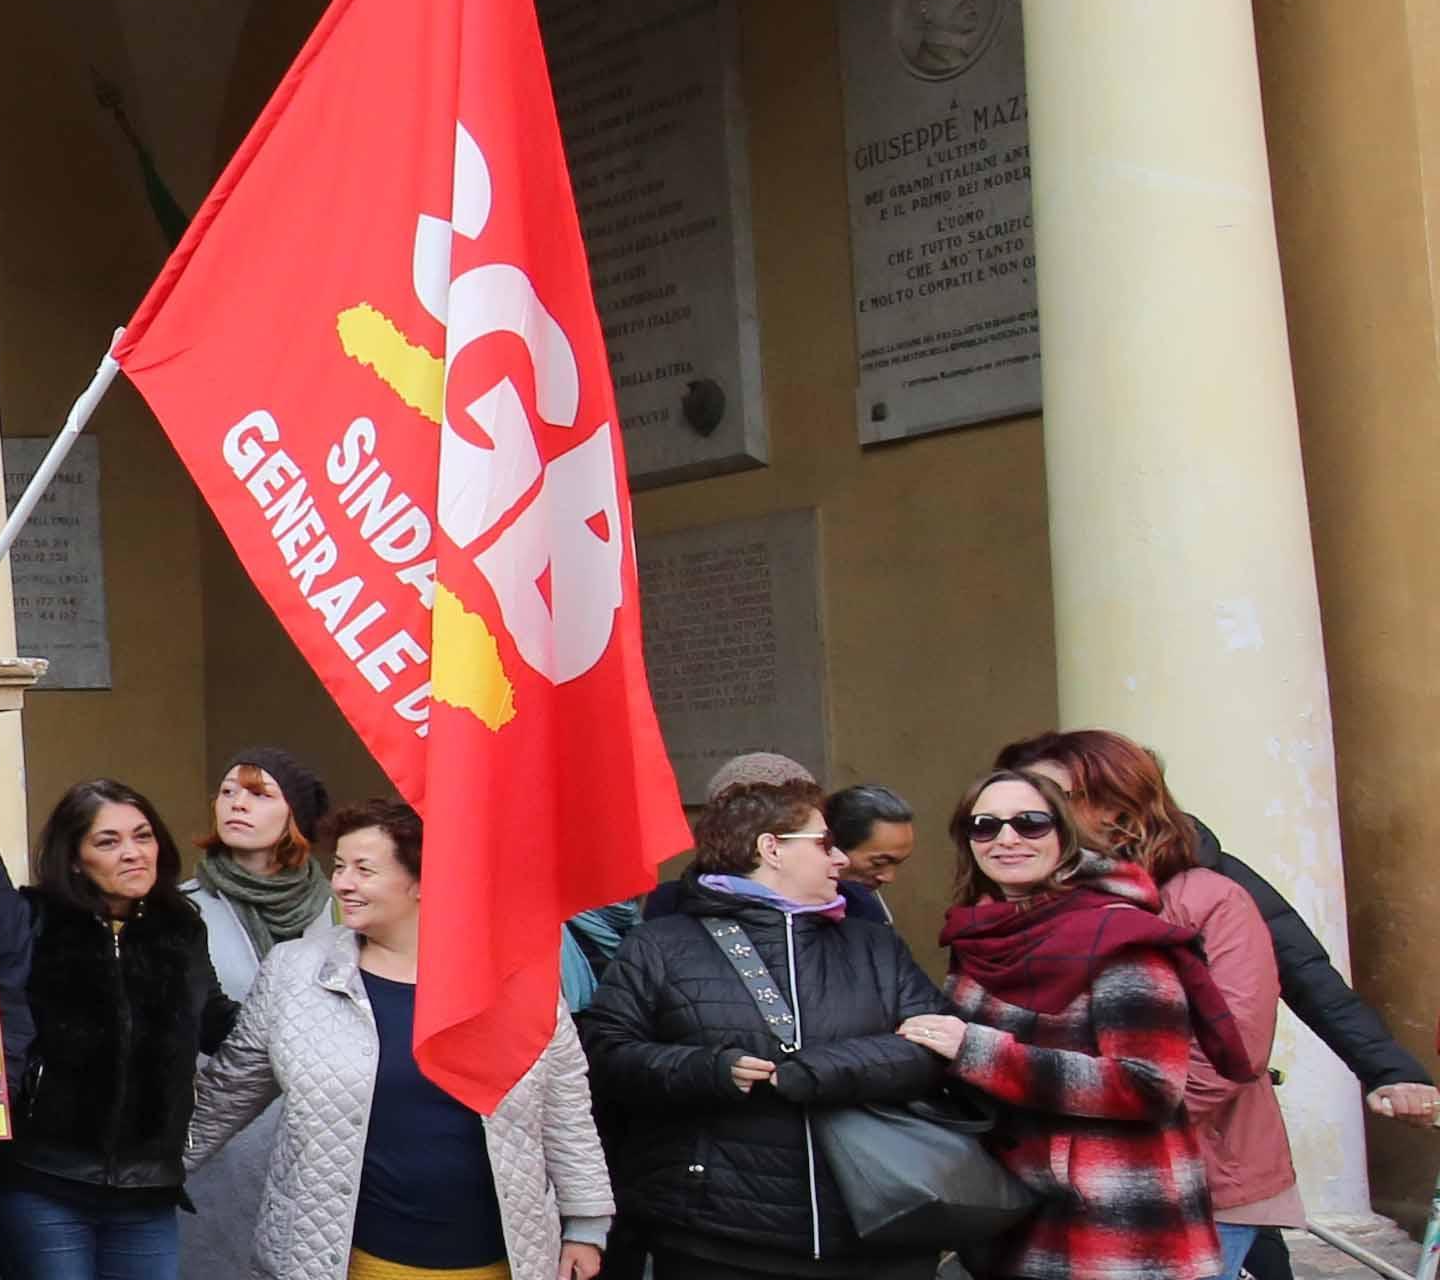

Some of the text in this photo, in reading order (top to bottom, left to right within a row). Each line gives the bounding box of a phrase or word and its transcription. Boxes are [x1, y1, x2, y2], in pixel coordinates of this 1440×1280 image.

[854, 96, 1027, 171] GIUSEPPE MAZ
[927, 138, 987, 168] L'ULTIMO
[889, 175, 934, 198] GRANDI
[939, 155, 998, 184] ITALIANI
[912, 189, 951, 213] PRIMO
[958, 184, 978, 199] DEI
[936, 208, 984, 233] L'UOMO
[888, 249, 913, 267] CHE
[921, 233, 962, 257] TUTTO
[907, 264, 932, 281] CHE
[977, 237, 1024, 262] TANTO
[870, 288, 914, 310] MOLTO
[989, 258, 1016, 276] NON
[413, 119, 625, 687] SGB
[222, 409, 430, 694] GENERALE
